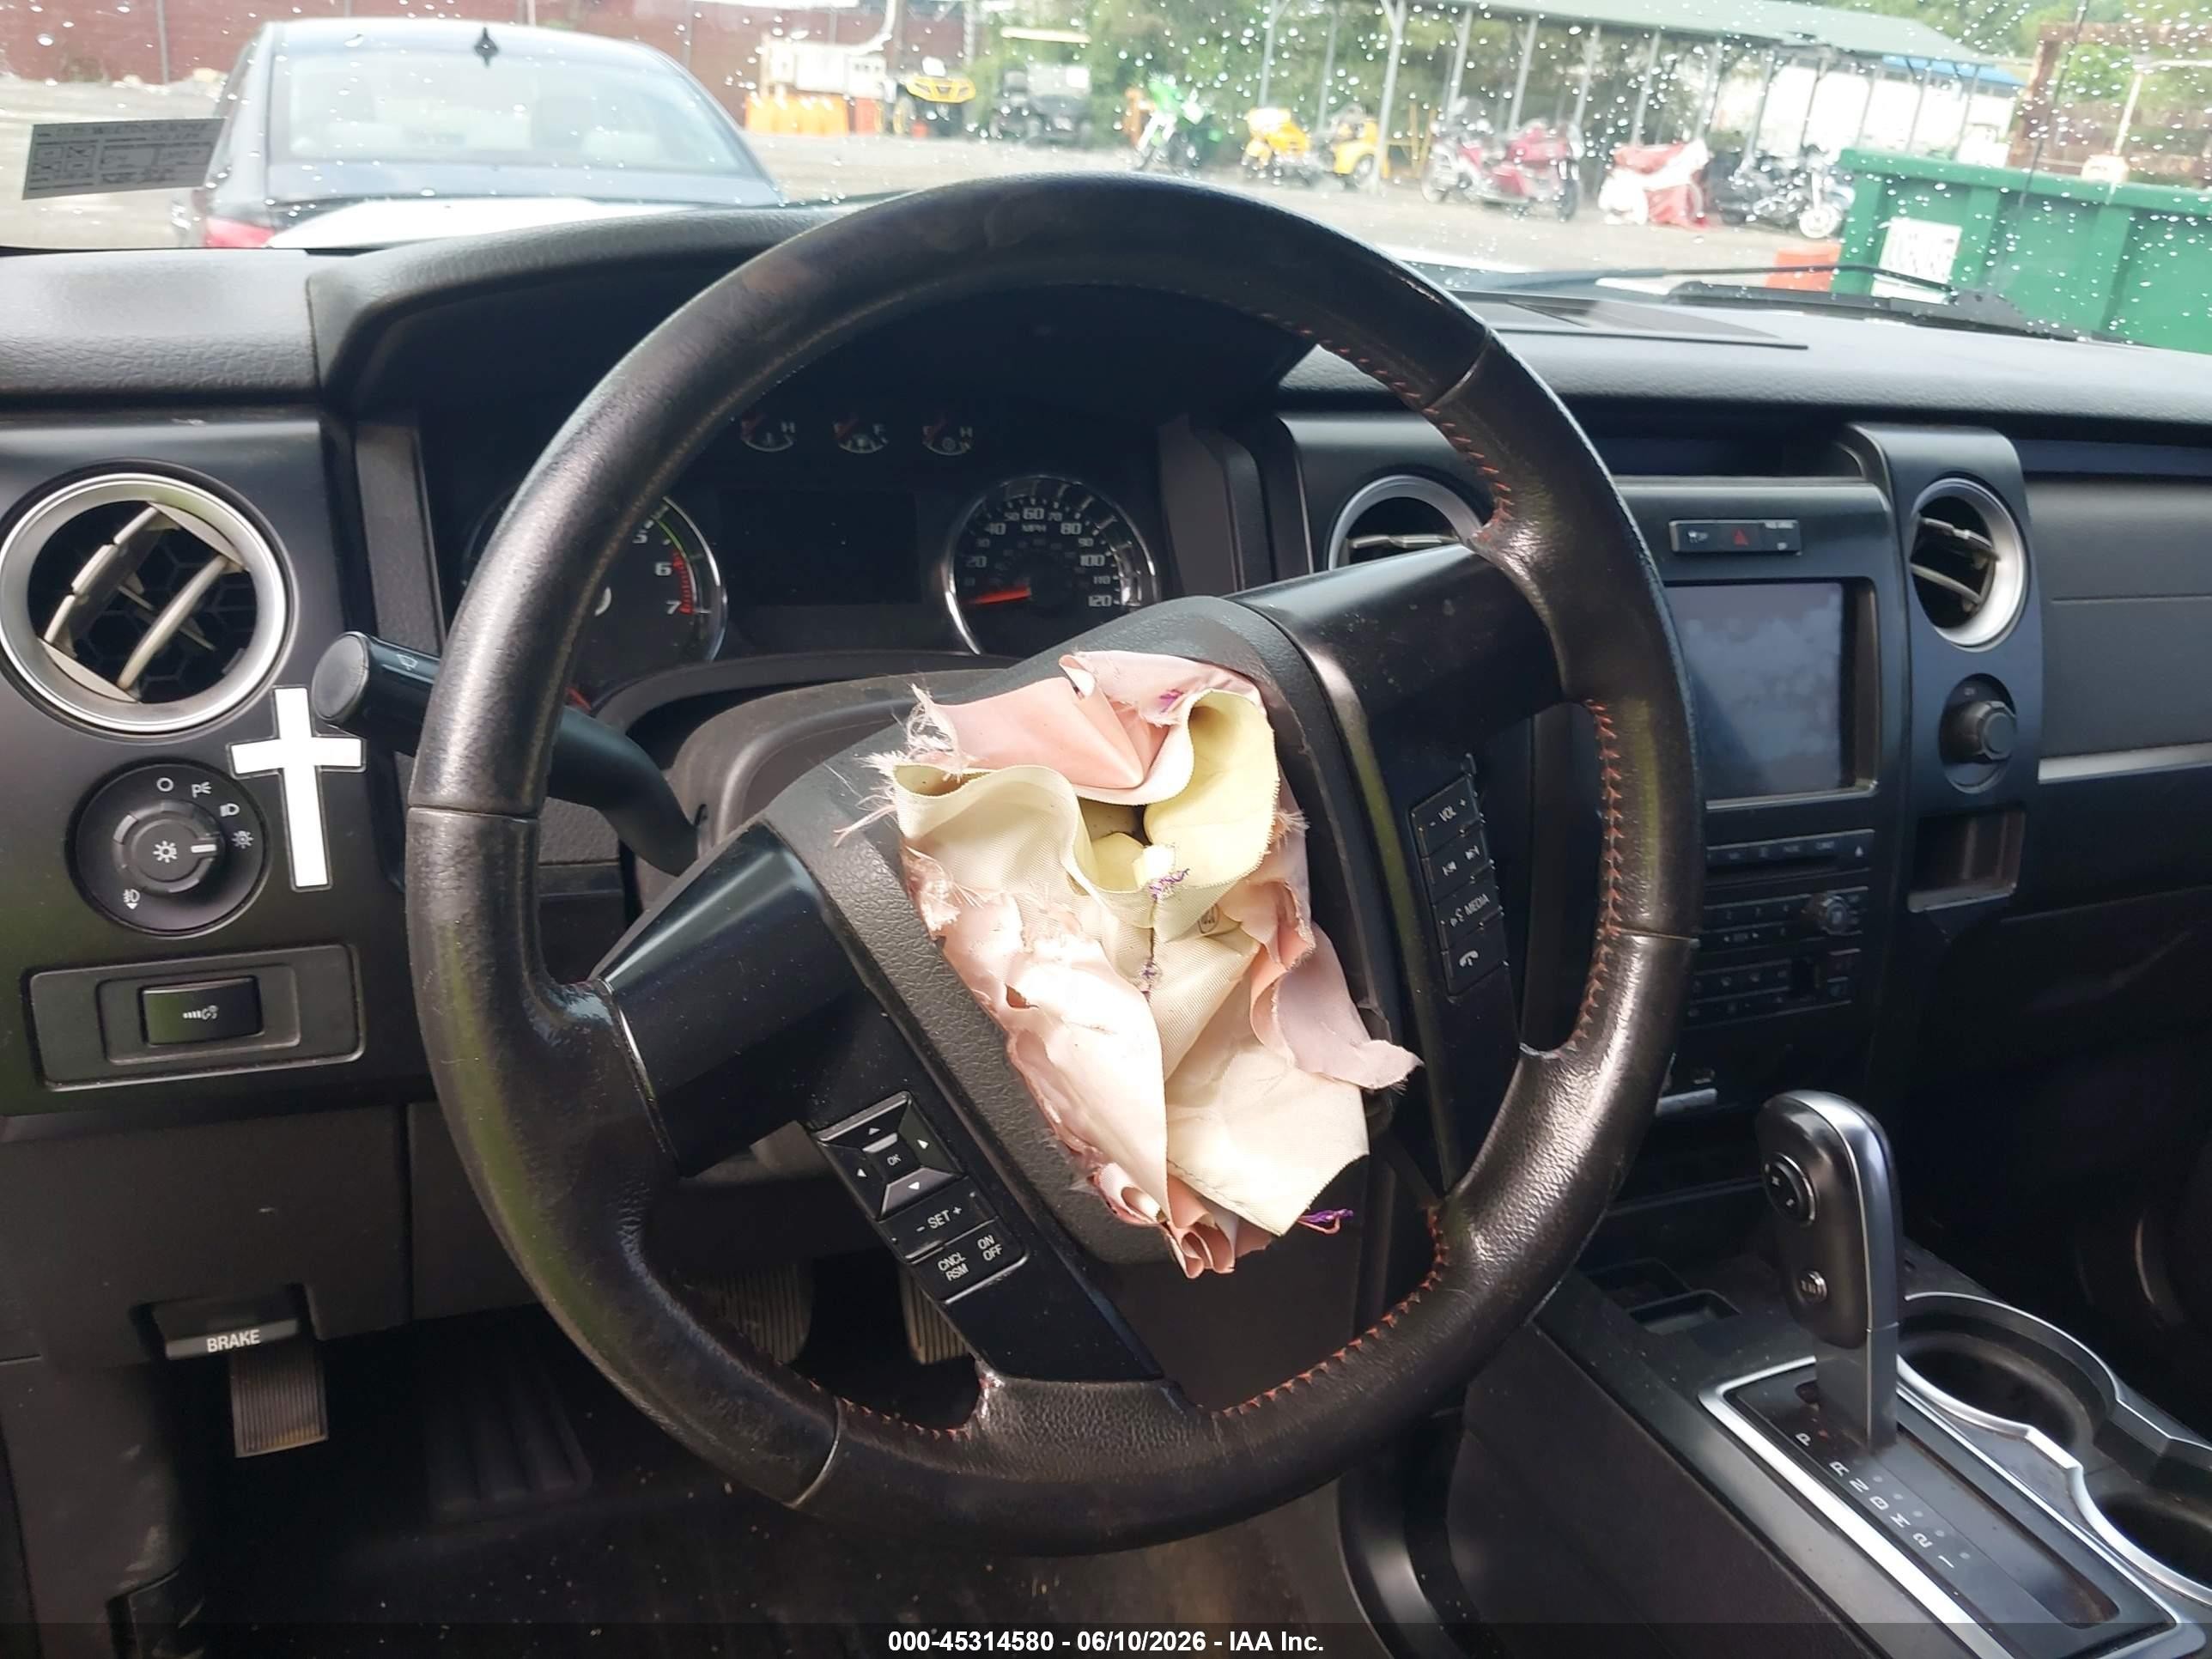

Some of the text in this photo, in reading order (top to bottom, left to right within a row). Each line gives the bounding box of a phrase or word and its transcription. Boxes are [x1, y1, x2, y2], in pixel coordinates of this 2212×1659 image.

[1023, 507, 1045, 520] 60
[1048, 513, 1062, 521] 70
[1060, 523, 1082, 535] 80
[1078, 538, 1094, 547] 90
[966, 556, 987, 568] 20
[1079, 556, 1105, 567] 100
[655, 562, 672, 576] 6
[666, 601, 682, 615] 7
[1088, 595, 1112, 607] 120
[1438, 805, 1457, 822] VOL
[1464, 893, 1490, 915] MEDIA
[887, 1152, 902, 1166] OK
[927, 1210, 951, 1230] SET
[977, 1234, 995, 1250] ON
[982, 1244, 1003, 1261] OFF
[938, 1251, 967, 1272] CNCL
[945, 1263, 969, 1281] RSM
[206, 1329, 261, 1353] BRAKE
[1796, 1432, 1812, 1447] P
[1829, 1461, 1850, 1476] R
[1849, 1478, 1869, 1492] N
[1869, 1496, 1889, 1510] D
[1890, 1513, 1911, 1528] M
[1912, 1532, 1934, 1547] 2
